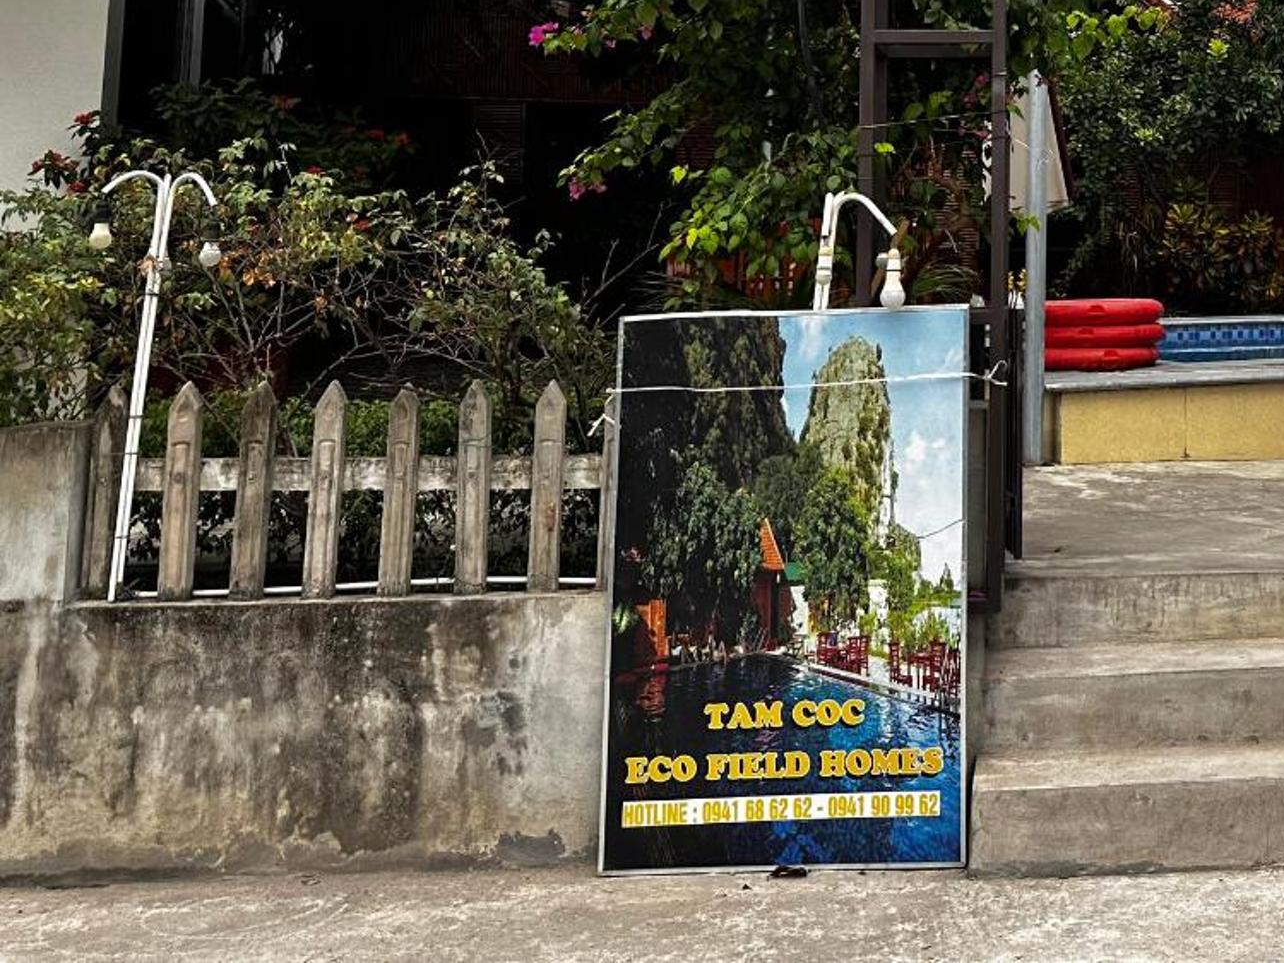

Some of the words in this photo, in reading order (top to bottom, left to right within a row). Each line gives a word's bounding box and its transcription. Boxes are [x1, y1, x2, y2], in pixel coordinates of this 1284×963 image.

[704, 700, 783, 729] TAM
[792, 698, 866, 727] COC
[624, 754, 698, 784] ECO
[705, 751, 810, 780] FIELD
[819, 747, 944, 777] HOMES
[624, 801, 689, 825] HOTLINE
[703, 800, 738, 822] 0941
[745, 799, 764, 820] 68
[769, 798, 788, 819] 62
[793, 797, 812, 818] 62
[828, 795, 864, 817] 0941
[871, 794, 890, 816] 90
[895, 794, 914, 815] 99
[919, 793, 938, 815] 62
